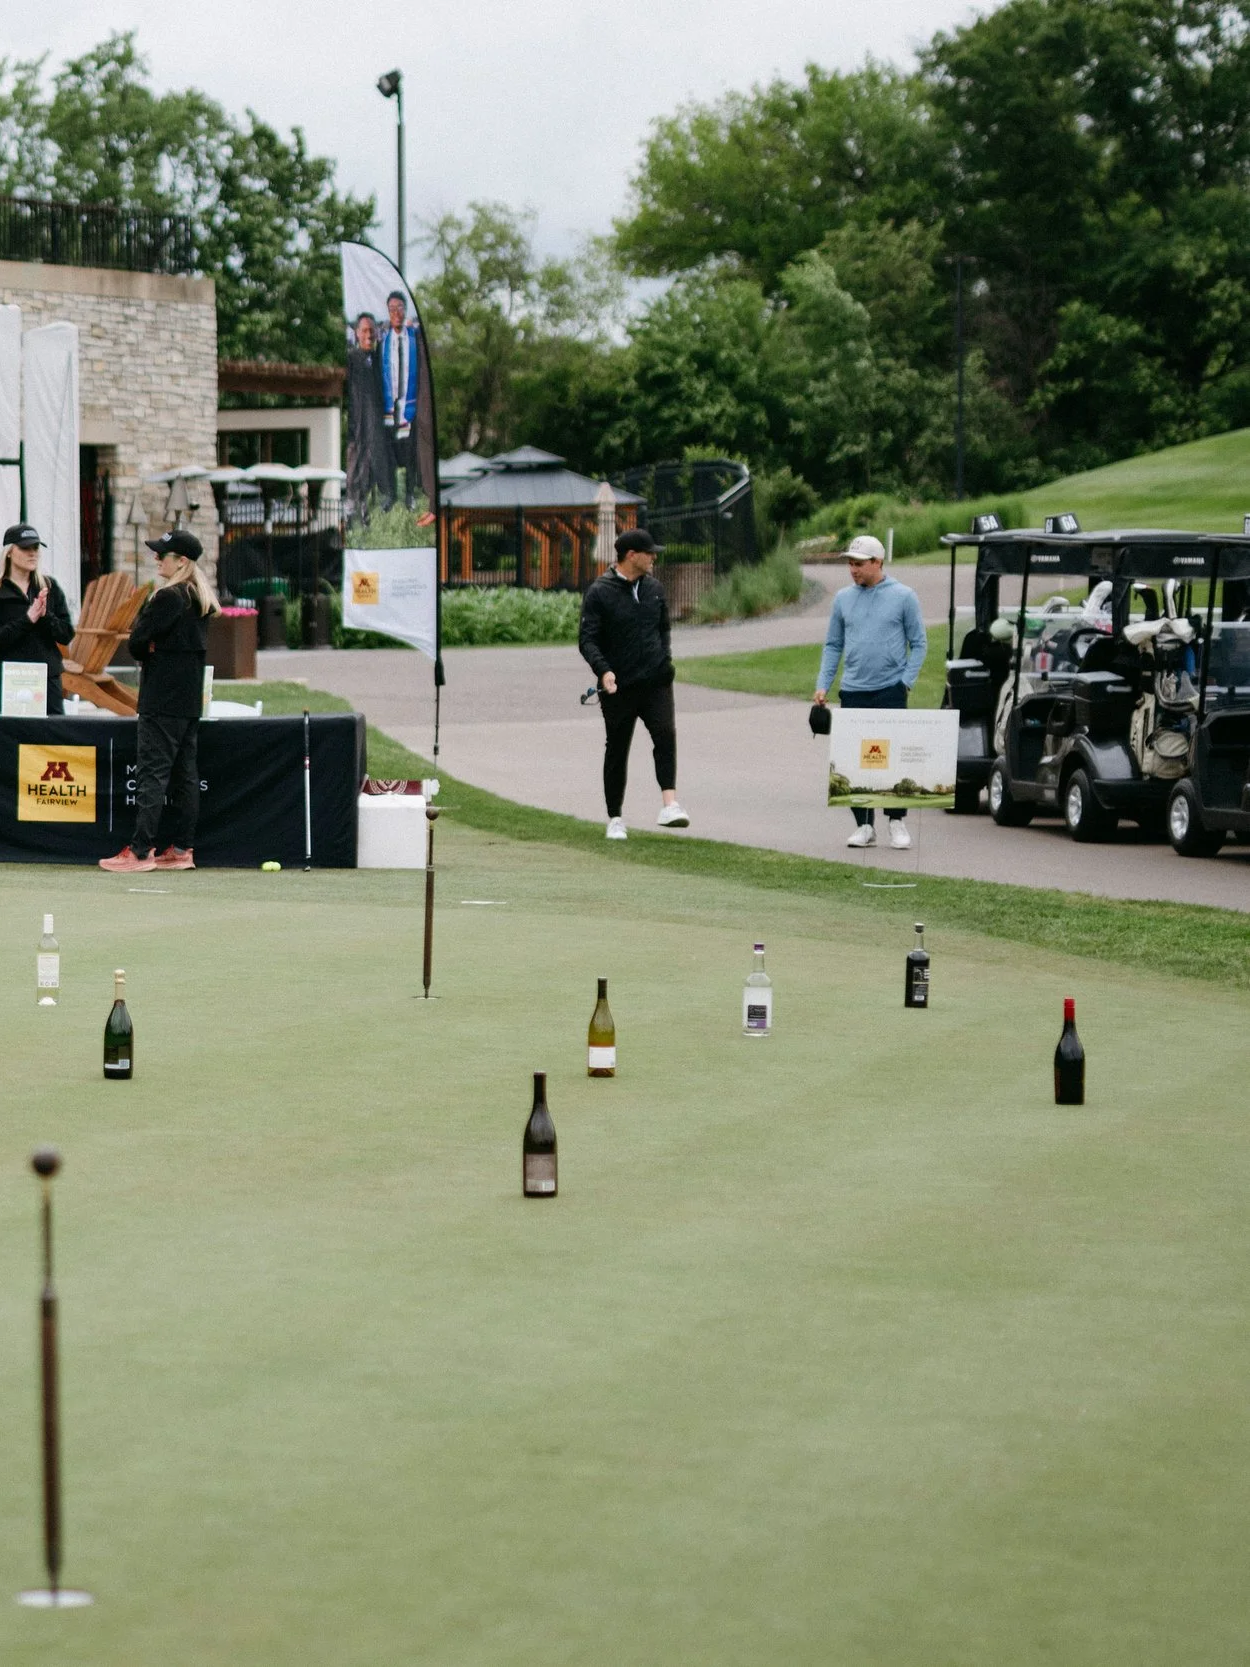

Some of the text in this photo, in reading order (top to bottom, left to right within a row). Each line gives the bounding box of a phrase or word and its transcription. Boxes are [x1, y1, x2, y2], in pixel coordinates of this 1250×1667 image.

[980, 515, 998, 530] 5A
[1062, 515, 1077, 531] 6A
[1038, 554, 1060, 562] YAMAHA
[1180, 557, 1204, 565] YAMAHA
[40, 761, 74, 781] M
[27, 784, 87, 797] HEALTH
[36, 797, 78, 806] FAIRVIEW
